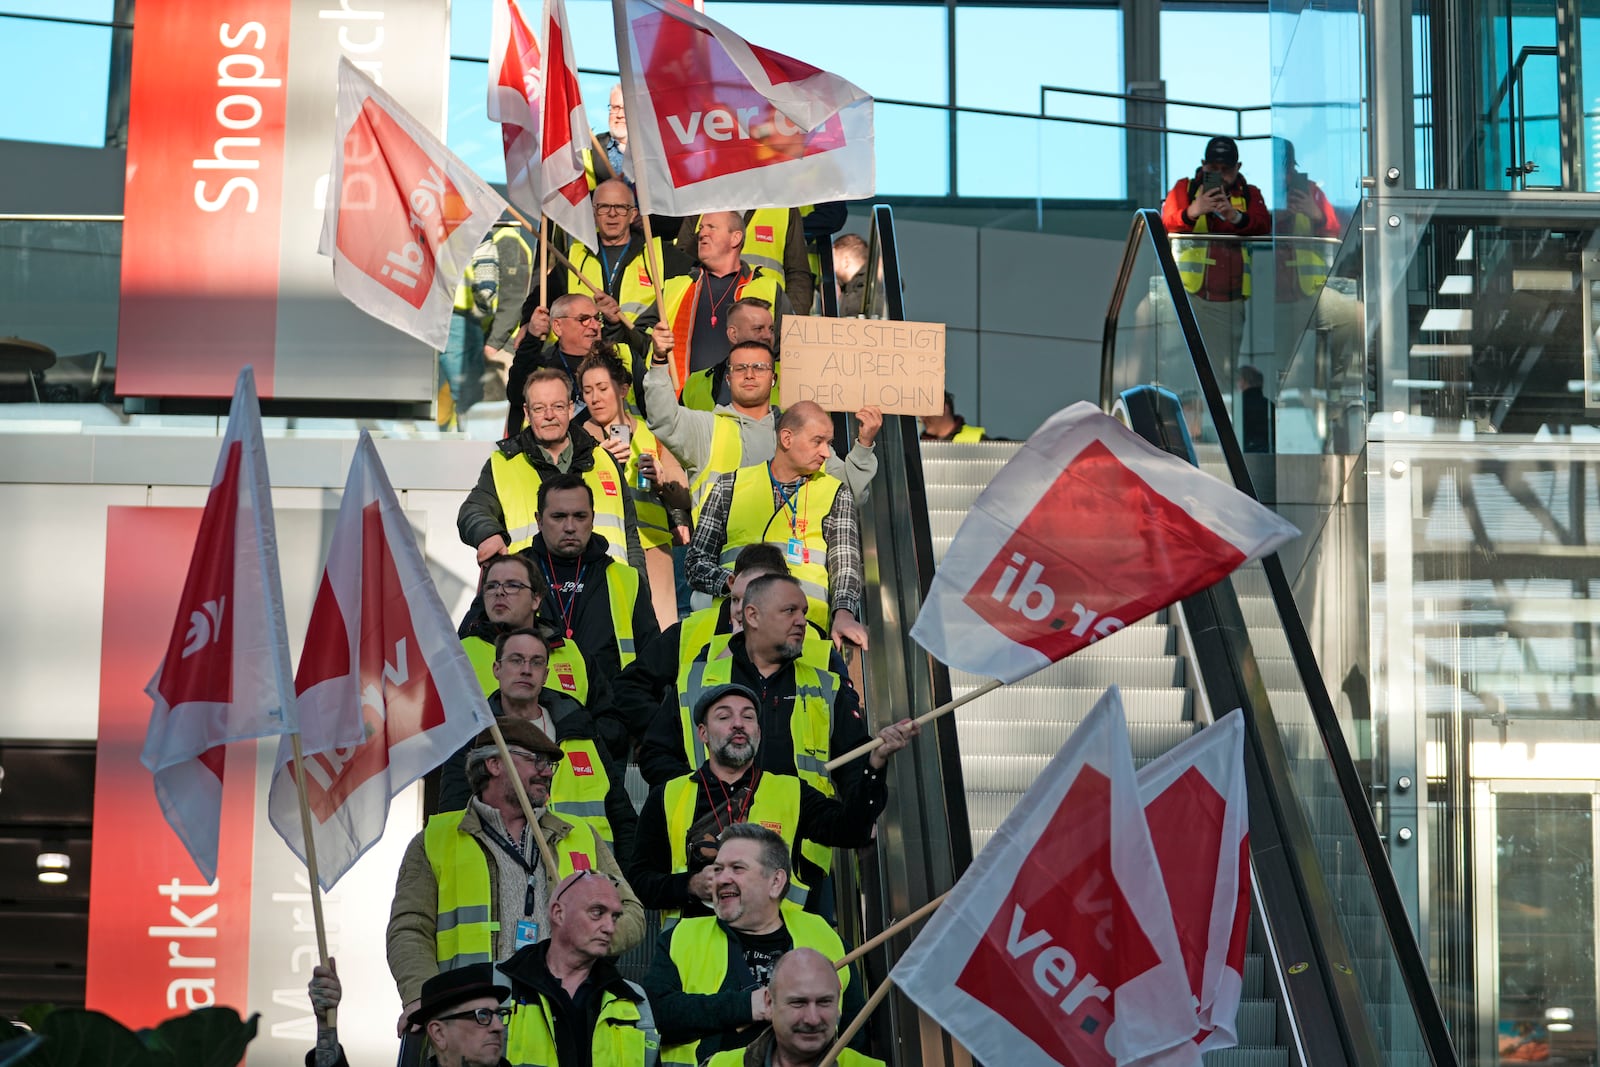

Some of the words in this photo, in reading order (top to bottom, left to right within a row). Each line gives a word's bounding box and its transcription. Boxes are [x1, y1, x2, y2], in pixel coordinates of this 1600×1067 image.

[193, 21, 283, 214] Shops
[783, 319, 858, 346] ALLES
[863, 324, 944, 350] STEIGT
[799, 383, 845, 406] DER
[862, 383, 934, 409] LOHN
[148, 876, 220, 1010] arkt
[271, 871, 341, 1041] Mark
